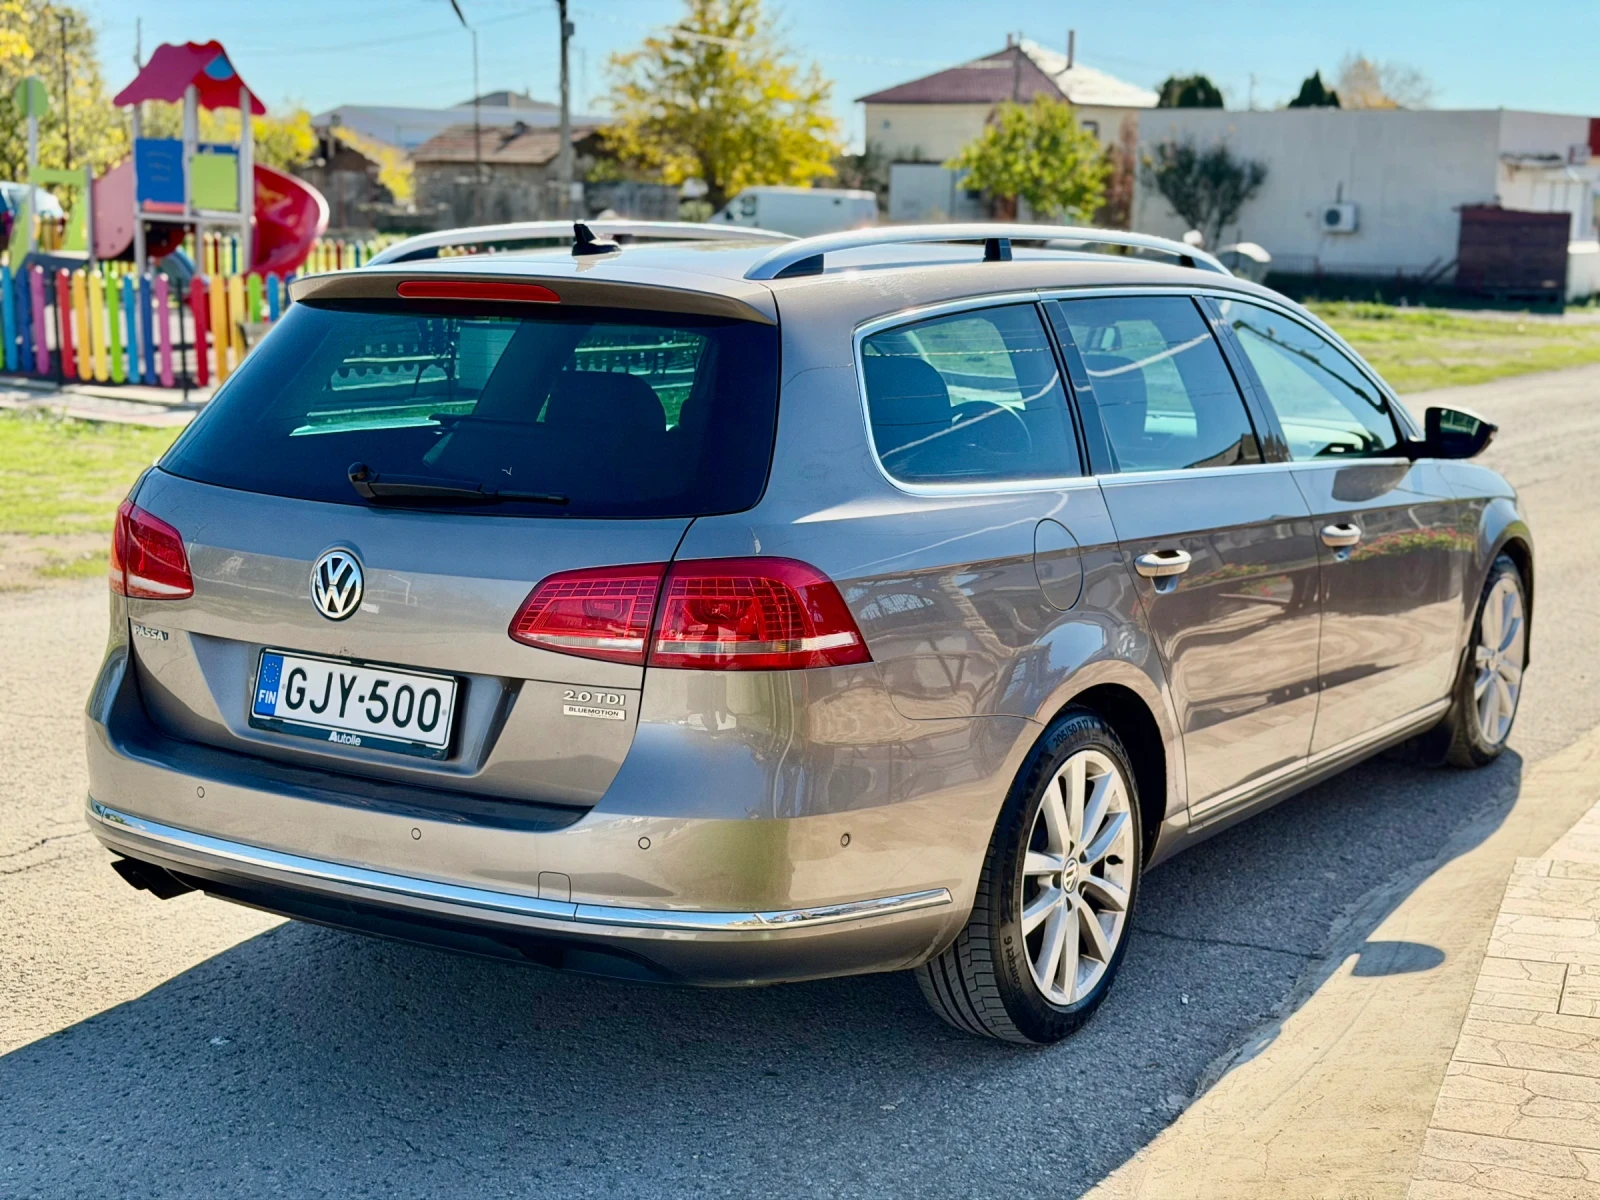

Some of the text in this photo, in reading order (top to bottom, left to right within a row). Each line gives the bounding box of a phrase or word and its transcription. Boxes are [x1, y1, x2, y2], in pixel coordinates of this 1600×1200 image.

[258, 689, 277, 705] FIN
[563, 690, 625, 706] 2.0 TDI
[568, 706, 619, 717] BLUEMOTION
[328, 731, 361, 747] Autolle
